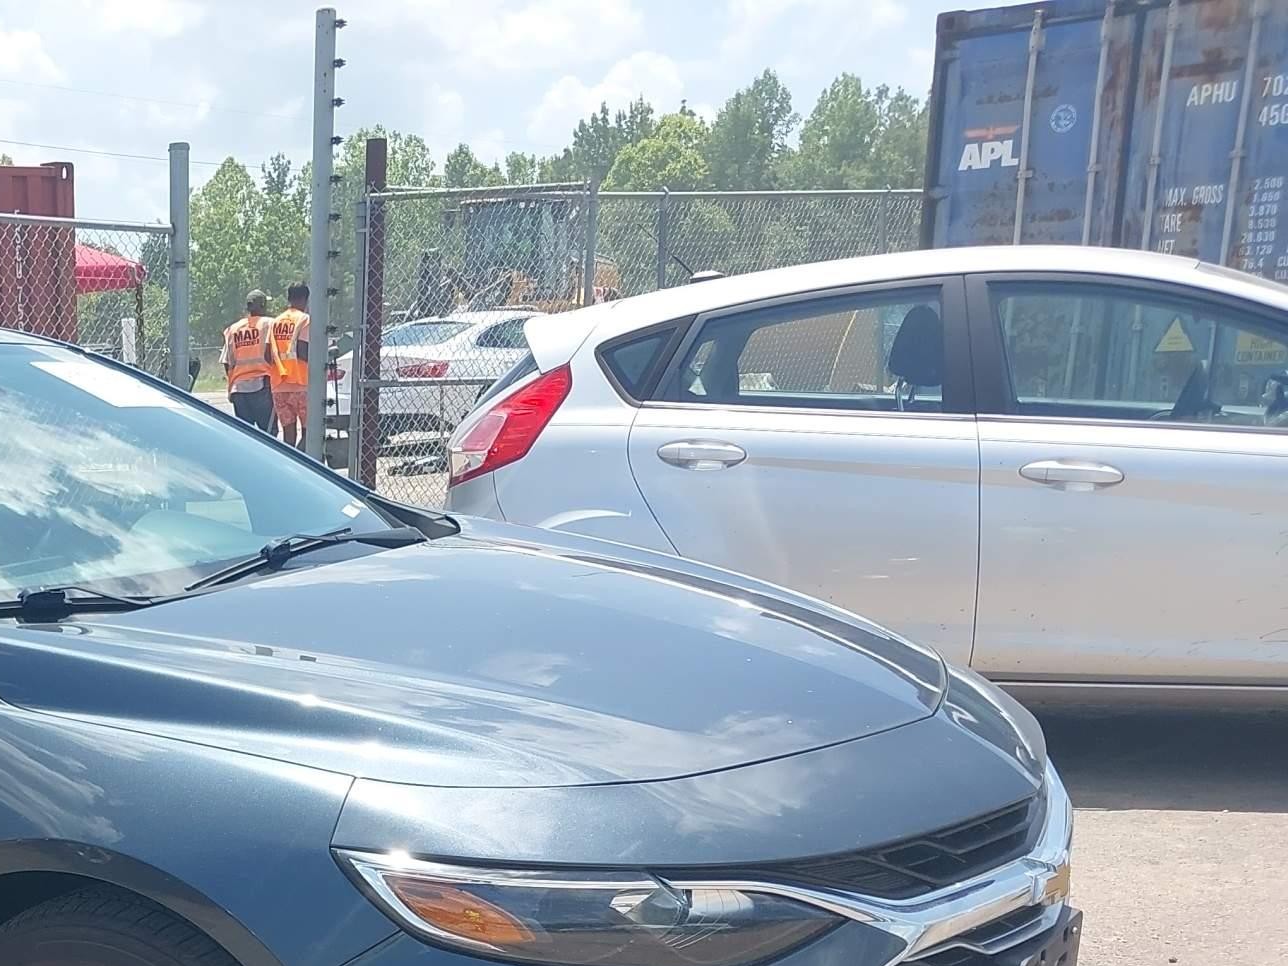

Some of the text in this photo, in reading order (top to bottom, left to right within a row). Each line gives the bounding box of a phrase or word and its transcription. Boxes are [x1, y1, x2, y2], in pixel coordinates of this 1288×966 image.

[1186, 79, 1239, 107] APHU
[958, 139, 1019, 171] APL
[1164, 184, 1224, 207] MAX. GROSS
[1160, 213, 1183, 233] TARE
[1156, 240, 1176, 256] NET
[233, 328, 259, 343] MAD
[273, 322, 295, 335] MAD
